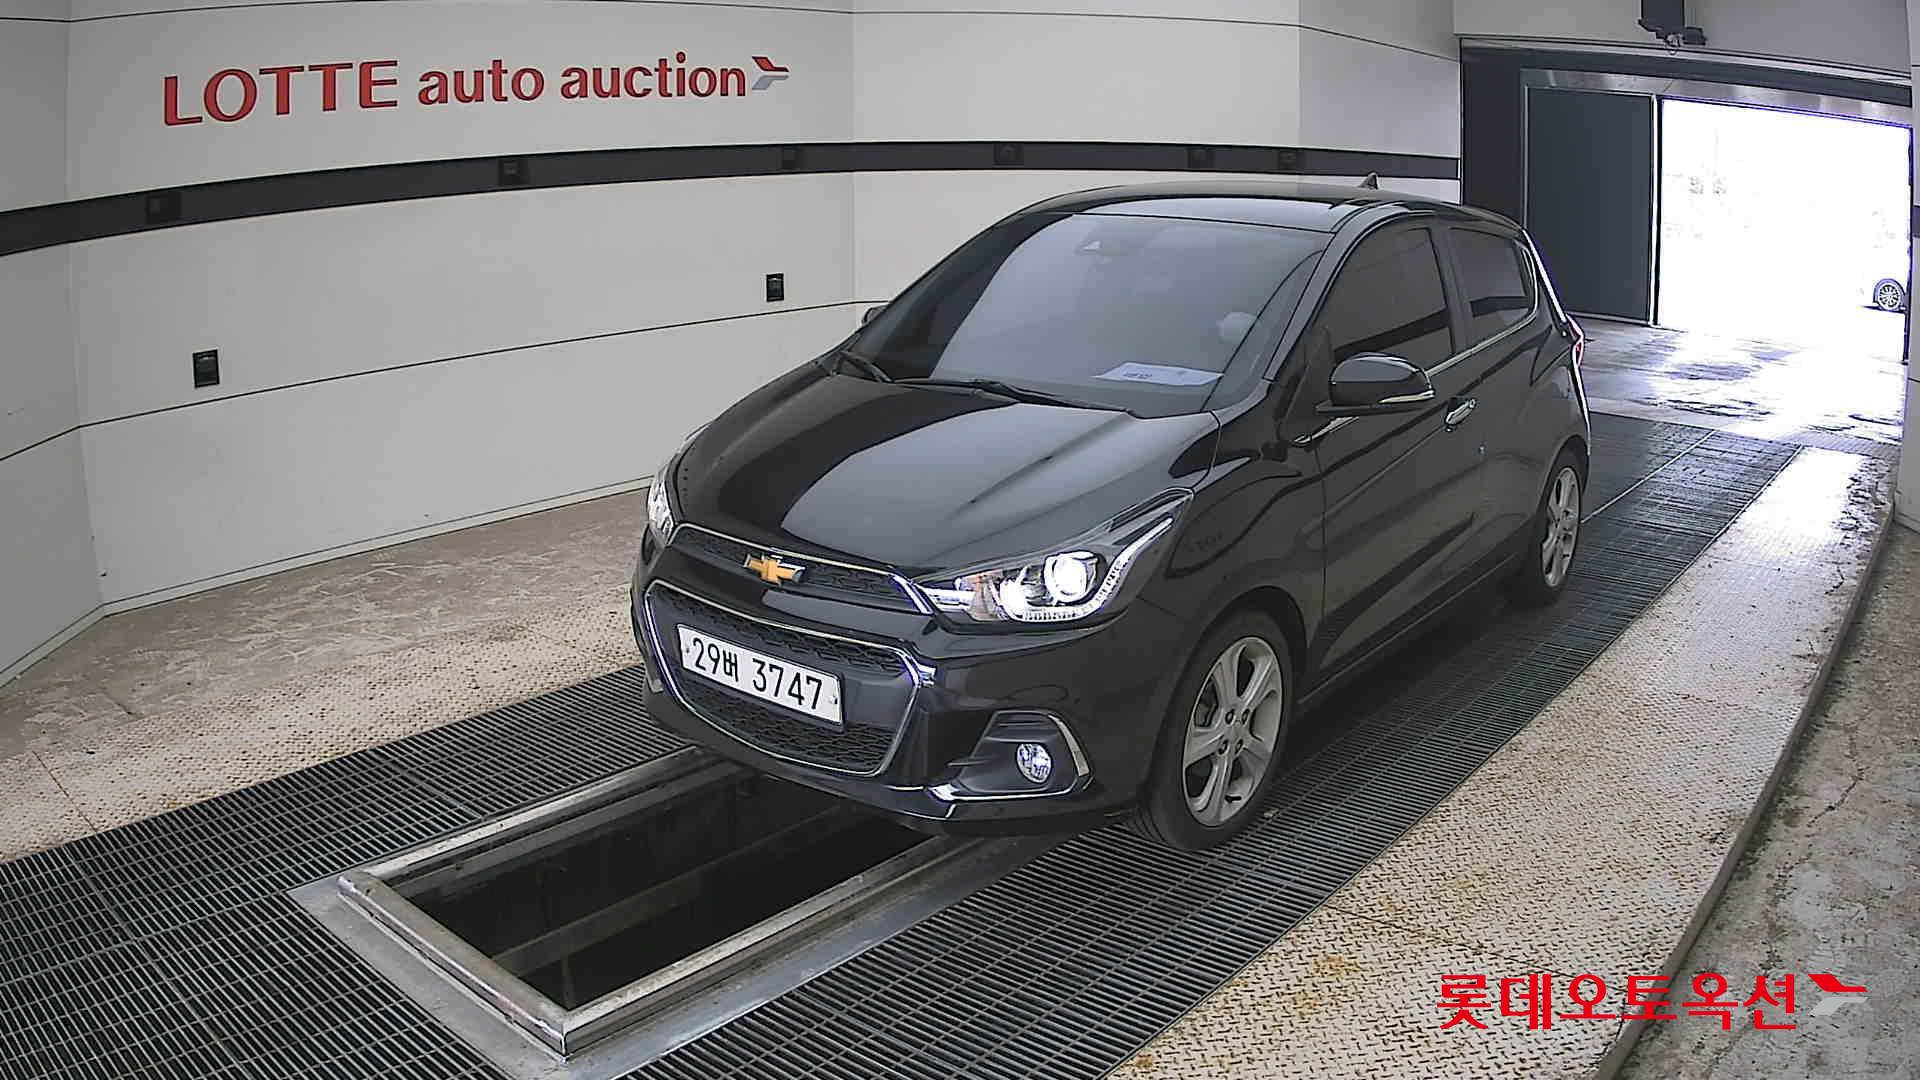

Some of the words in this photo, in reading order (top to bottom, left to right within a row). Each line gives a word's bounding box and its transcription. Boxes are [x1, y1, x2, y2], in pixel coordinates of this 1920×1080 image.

[164, 60, 398, 126] LOTTE
[418, 59, 545, 105] auto
[561, 51, 747, 99] auction
[693, 637, 739, 682] 29버
[752, 657, 823, 710] 3747
